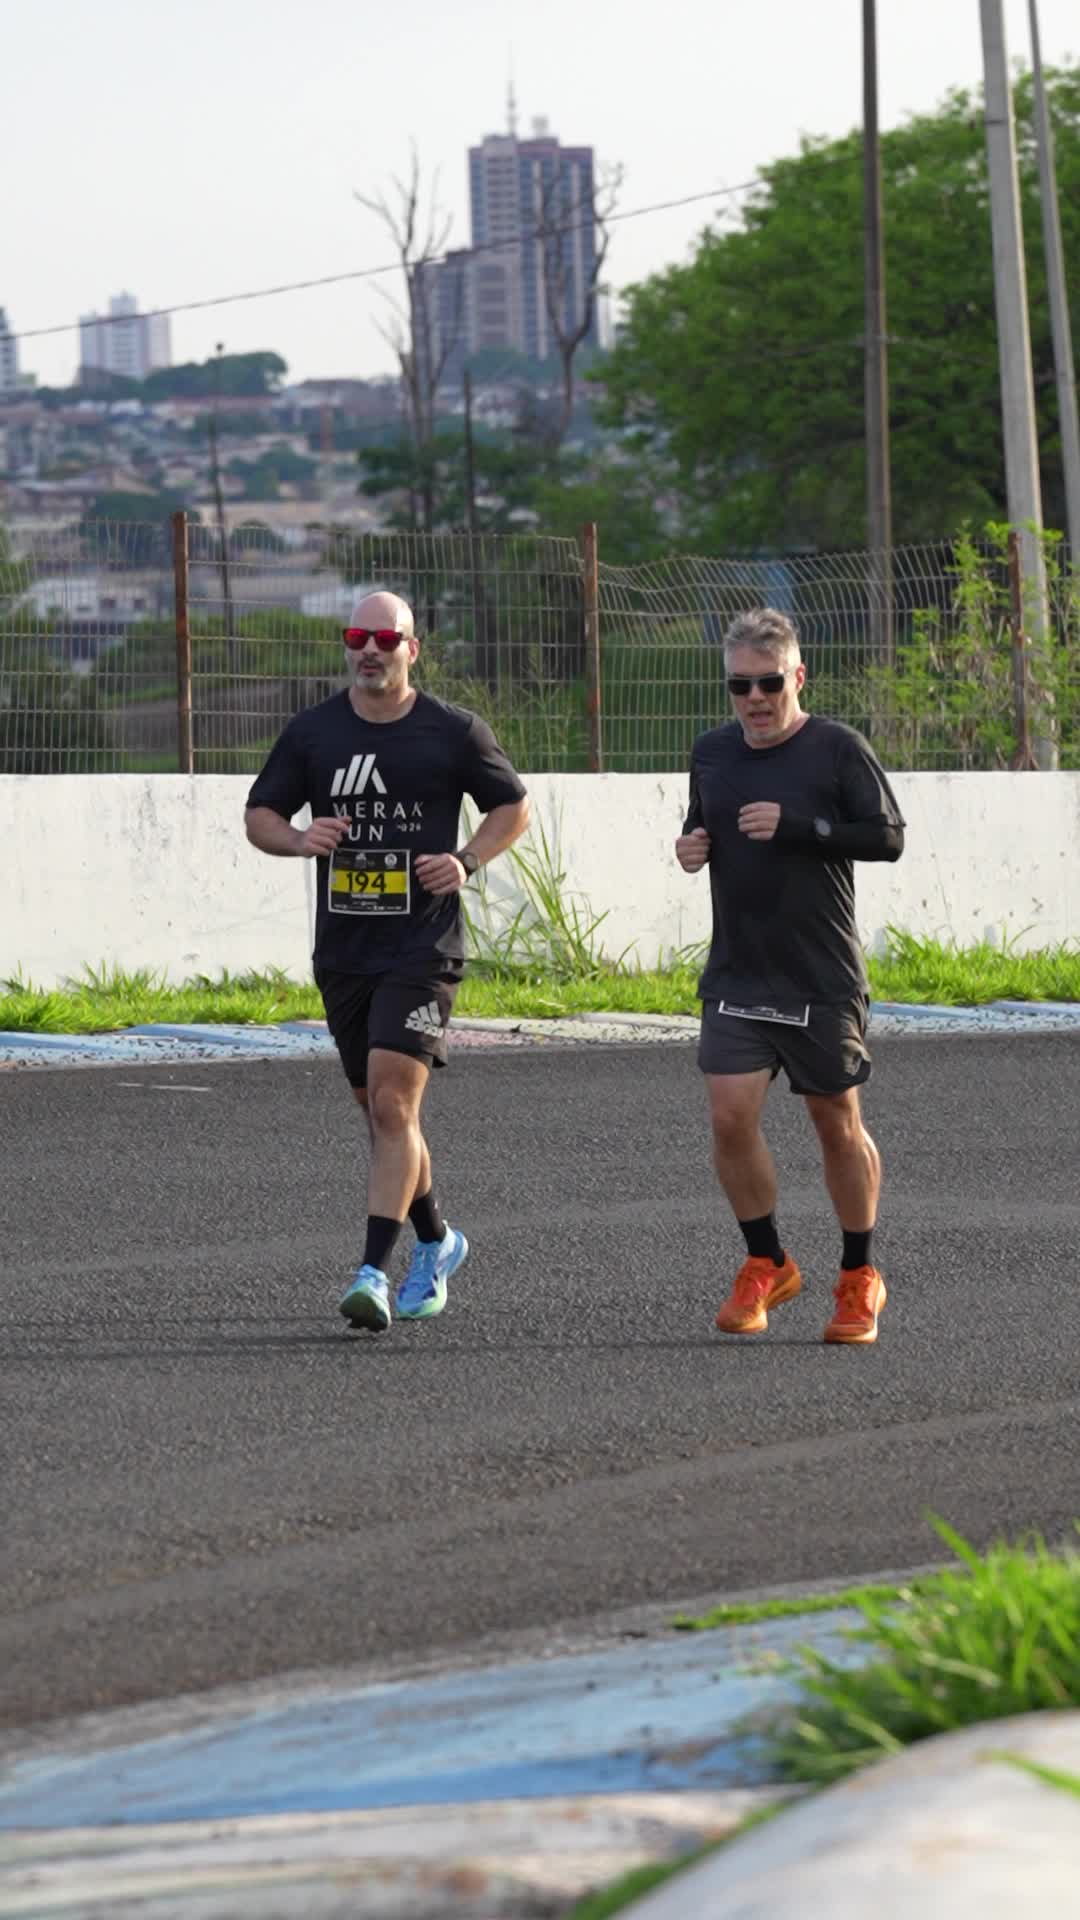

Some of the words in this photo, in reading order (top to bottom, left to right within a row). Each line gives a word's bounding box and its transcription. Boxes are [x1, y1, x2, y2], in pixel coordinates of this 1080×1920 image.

[332, 801, 423, 819] MERAK
[346, 823, 384, 842] UN
[346, 871, 387, 893] 194
